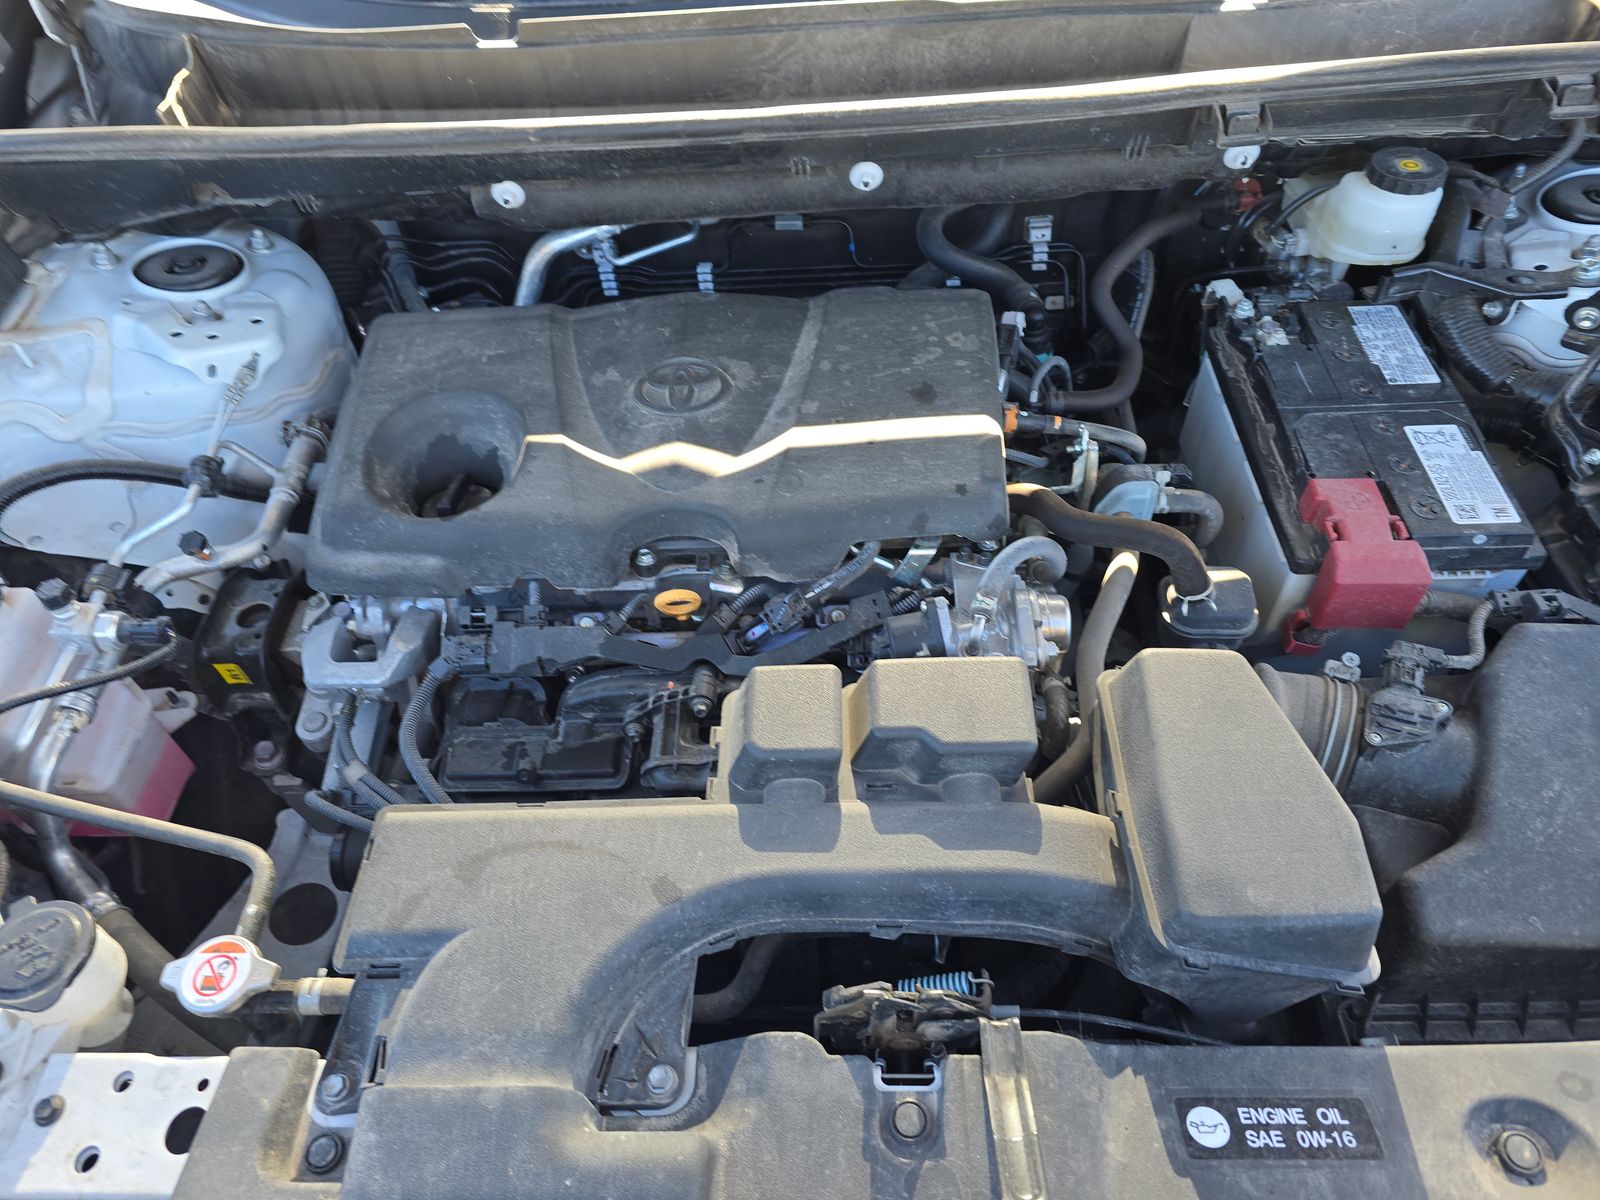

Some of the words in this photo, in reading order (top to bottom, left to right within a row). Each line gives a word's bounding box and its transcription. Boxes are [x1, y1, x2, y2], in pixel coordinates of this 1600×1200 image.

[1237, 1107, 1307, 1125] ENGINE
[1316, 1107, 1350, 1125] OIL
[1245, 1130, 1286, 1148] SAE
[1296, 1130, 1357, 1148] 0W-16
